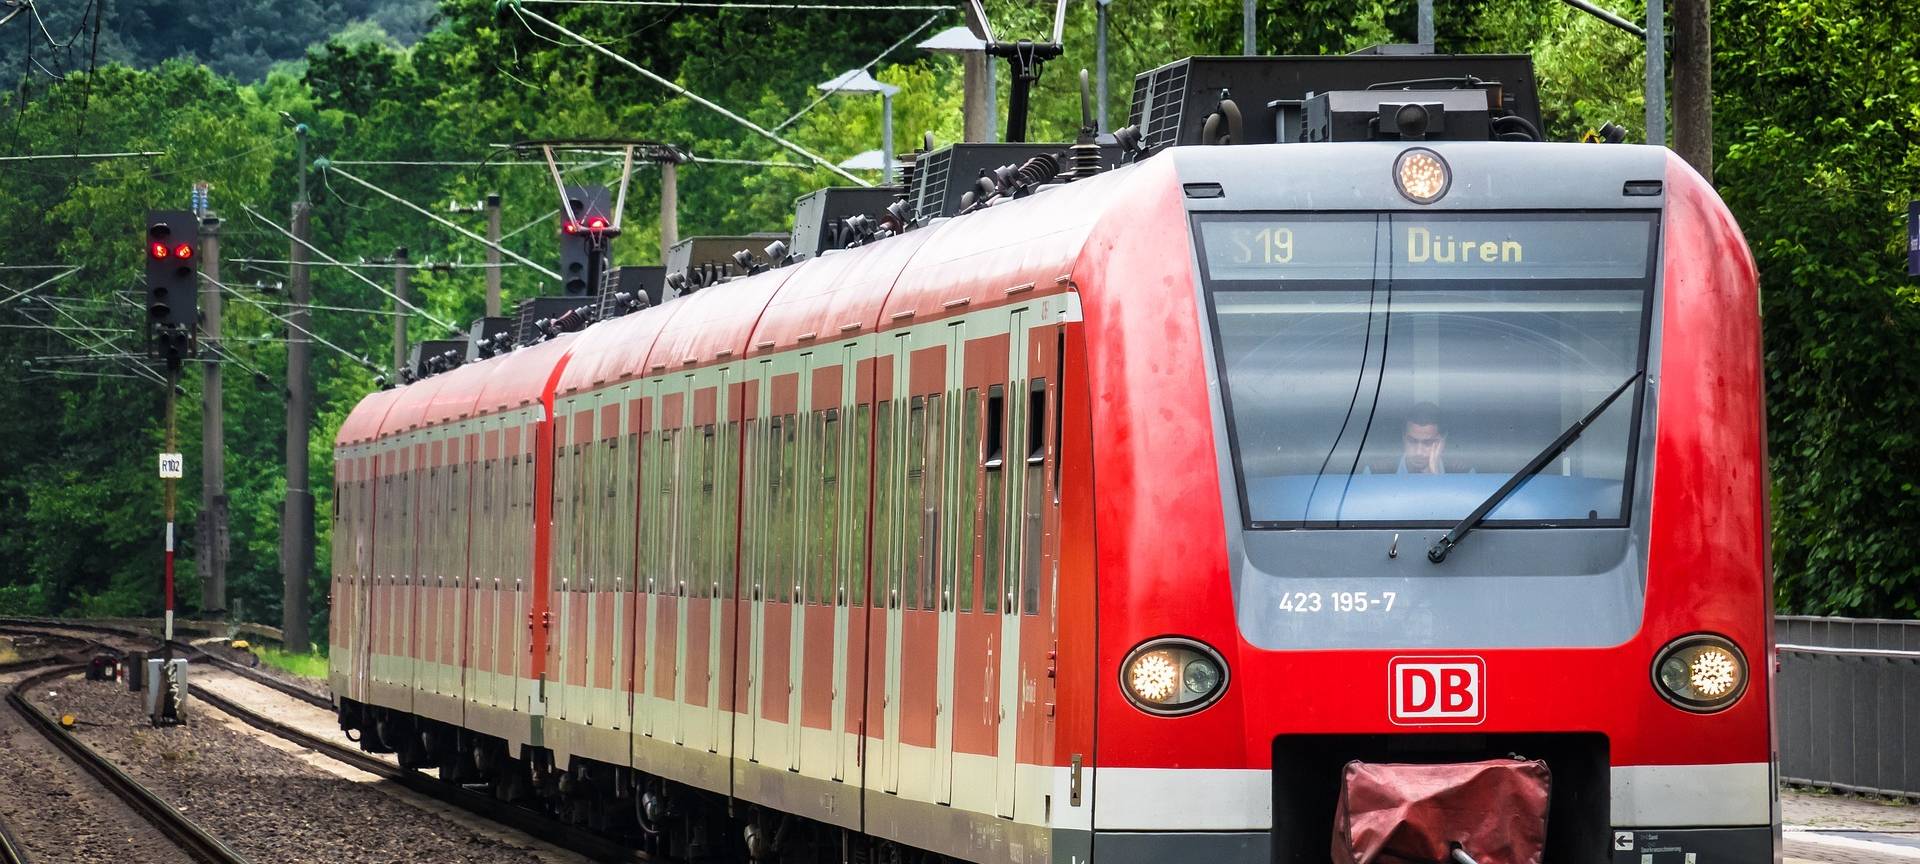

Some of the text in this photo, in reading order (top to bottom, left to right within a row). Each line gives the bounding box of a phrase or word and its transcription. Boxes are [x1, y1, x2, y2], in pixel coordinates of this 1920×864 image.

[1232, 227, 1523, 264] S19 Düren
[1279, 591, 1396, 612] 423 195-7
[1402, 668, 1474, 713] DB
